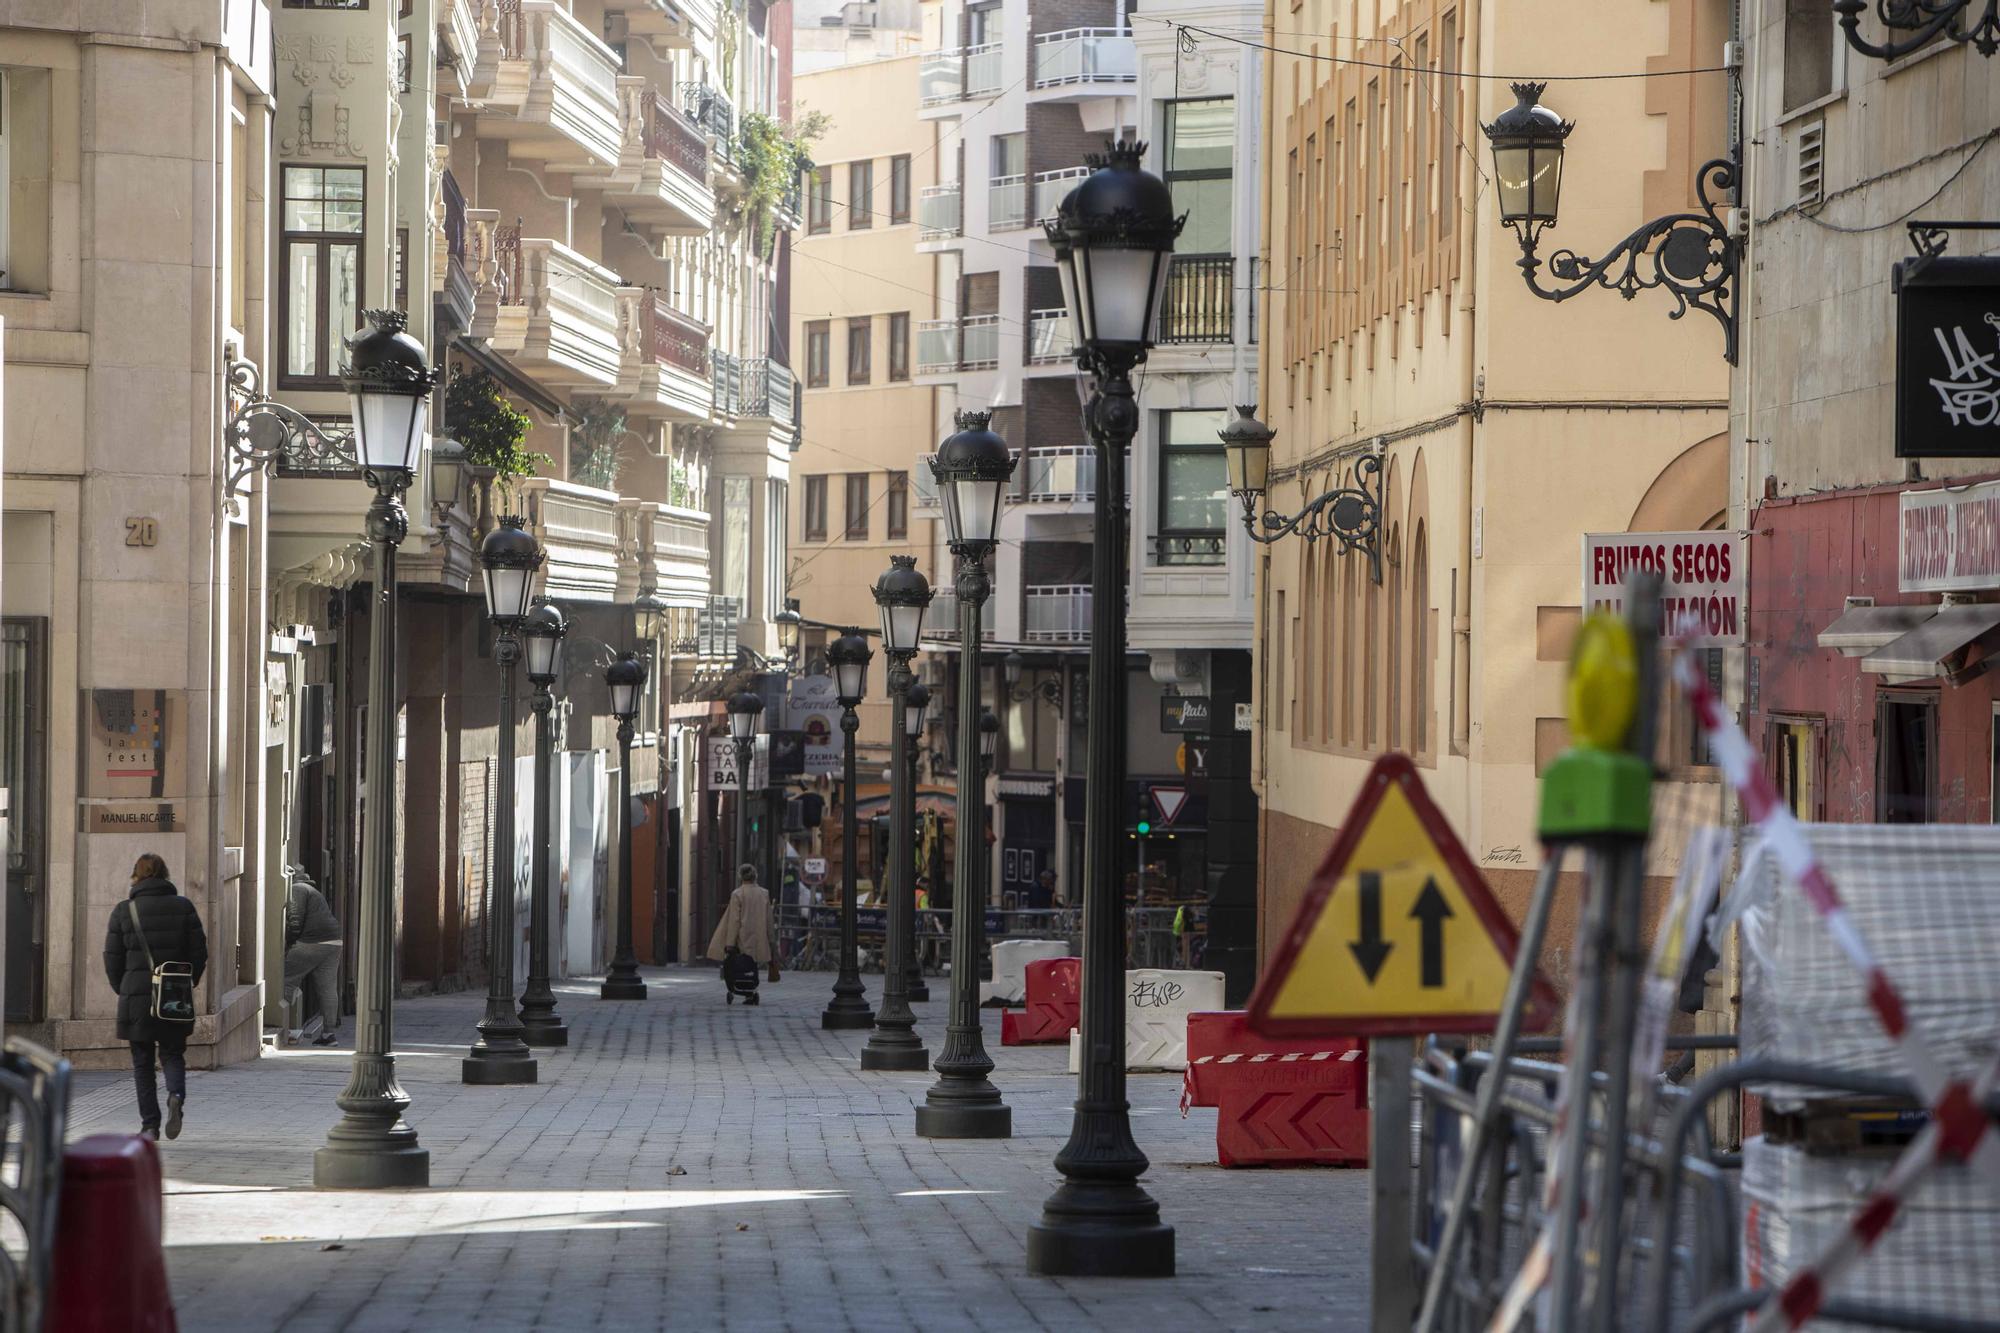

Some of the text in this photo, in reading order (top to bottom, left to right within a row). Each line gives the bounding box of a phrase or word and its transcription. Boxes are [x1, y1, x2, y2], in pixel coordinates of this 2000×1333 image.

[126, 516, 158, 547] 20
[1594, 543, 1731, 585] FRUTOS SECOS
[107, 739, 125, 748] la
[716, 756, 733, 768] TA
[714, 771, 737, 784] BA
[101, 813, 176, 823] MANUEL RICARTE
